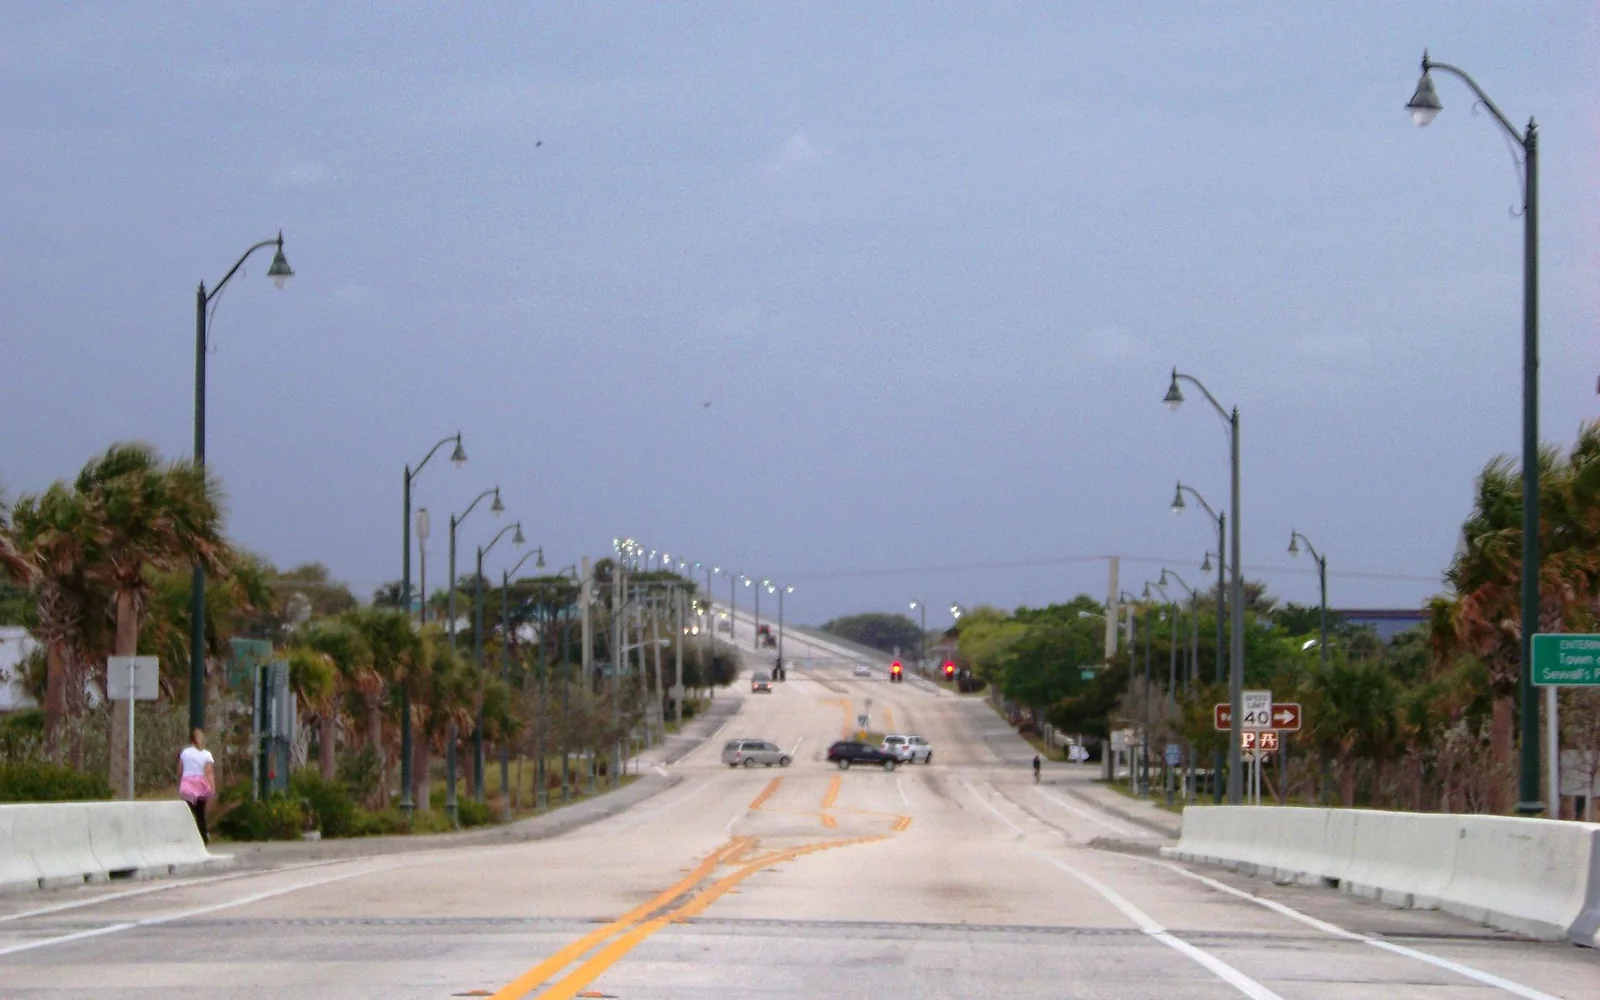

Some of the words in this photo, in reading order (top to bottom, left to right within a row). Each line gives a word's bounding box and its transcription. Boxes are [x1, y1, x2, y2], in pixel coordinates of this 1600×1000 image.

[1560, 652, 1594, 665] Town
[1244, 711, 1269, 725] 40
[1241, 732, 1255, 748] P
